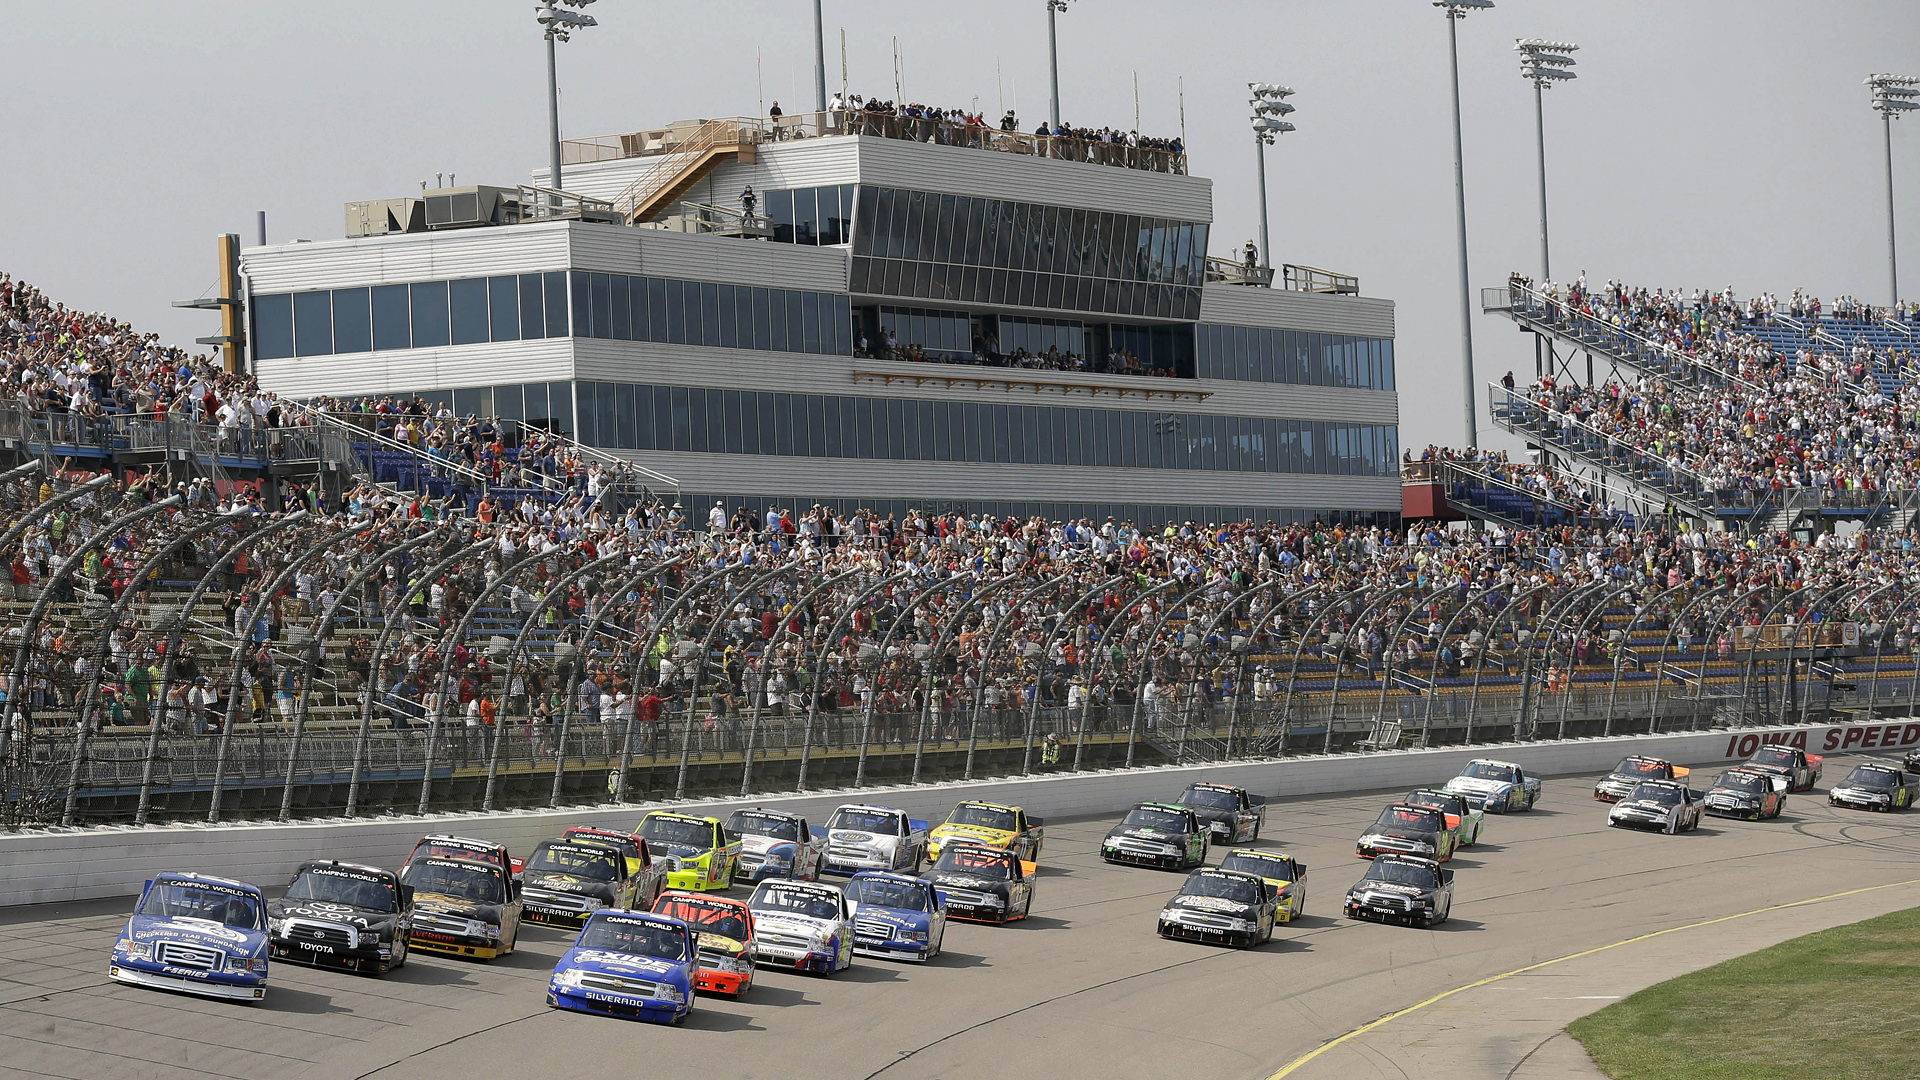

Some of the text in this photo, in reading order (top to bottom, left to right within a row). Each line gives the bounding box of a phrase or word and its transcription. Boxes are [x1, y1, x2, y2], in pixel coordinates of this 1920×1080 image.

[1822, 724, 1920, 750] SPEED
[430, 840, 488, 853] CAMPING WORLD
[426, 860, 488, 873] CAMPING WORLD
[312, 868, 378, 882] CAMPING WORLD
[170, 880, 244, 897] CAMPING WORLD
[532, 879, 583, 891] ARROWHEAD
[803, 888, 827, 896] WORLD
[526, 905, 574, 917] SILVERADO
[707, 900, 733, 909] WORLD
[1373, 907, 1395, 915] TOYOTA
[283, 906, 371, 929] TOYOTA
[606, 916, 672, 931] CAMPING WORLD
[1182, 924, 1224, 935] SILVERADO
[135, 930, 178, 939] CHECKERED
[203, 936, 250, 956] FOUNDATION
[299, 942, 334, 954] TOYOTA
[578, 950, 677, 973] EXIDE
[162, 966, 210, 979] F-SERIES
[586, 992, 644, 1007] SILVERADO
